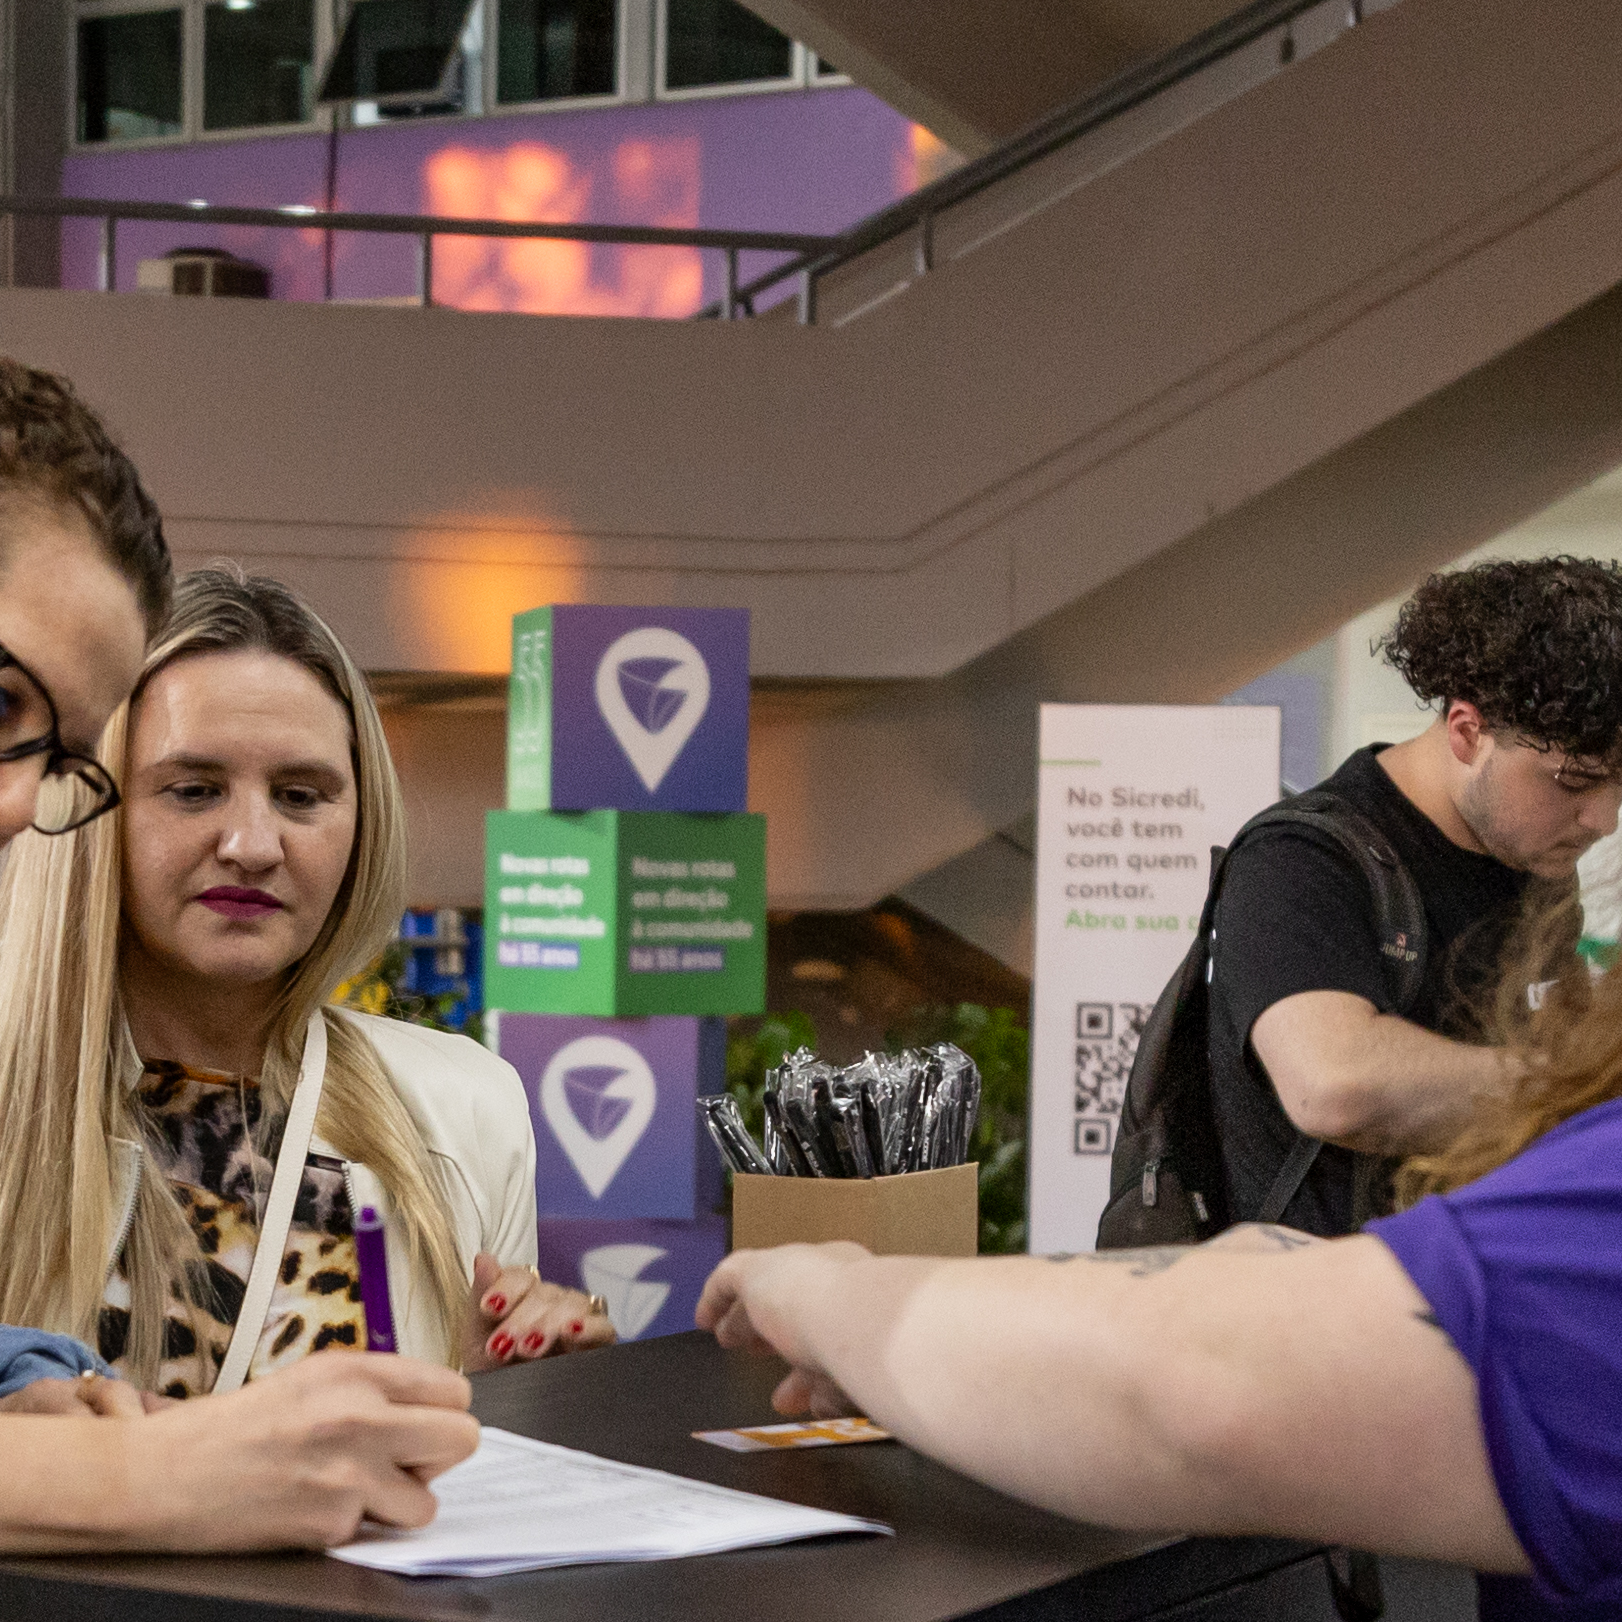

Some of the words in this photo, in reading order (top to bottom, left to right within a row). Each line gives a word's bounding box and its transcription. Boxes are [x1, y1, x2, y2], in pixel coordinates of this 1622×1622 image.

[1067, 786, 1104, 807] No
[1111, 786, 1206, 812] Sicredi,
[1066, 817, 1124, 838] você
[1132, 820, 1183, 838] tem
[1065, 853, 1119, 868] com
[1127, 853, 1198, 874] quem
[1065, 883, 1154, 899] contar.
[1065, 910, 1126, 929] Abra
[1135, 915, 1180, 931] sua
